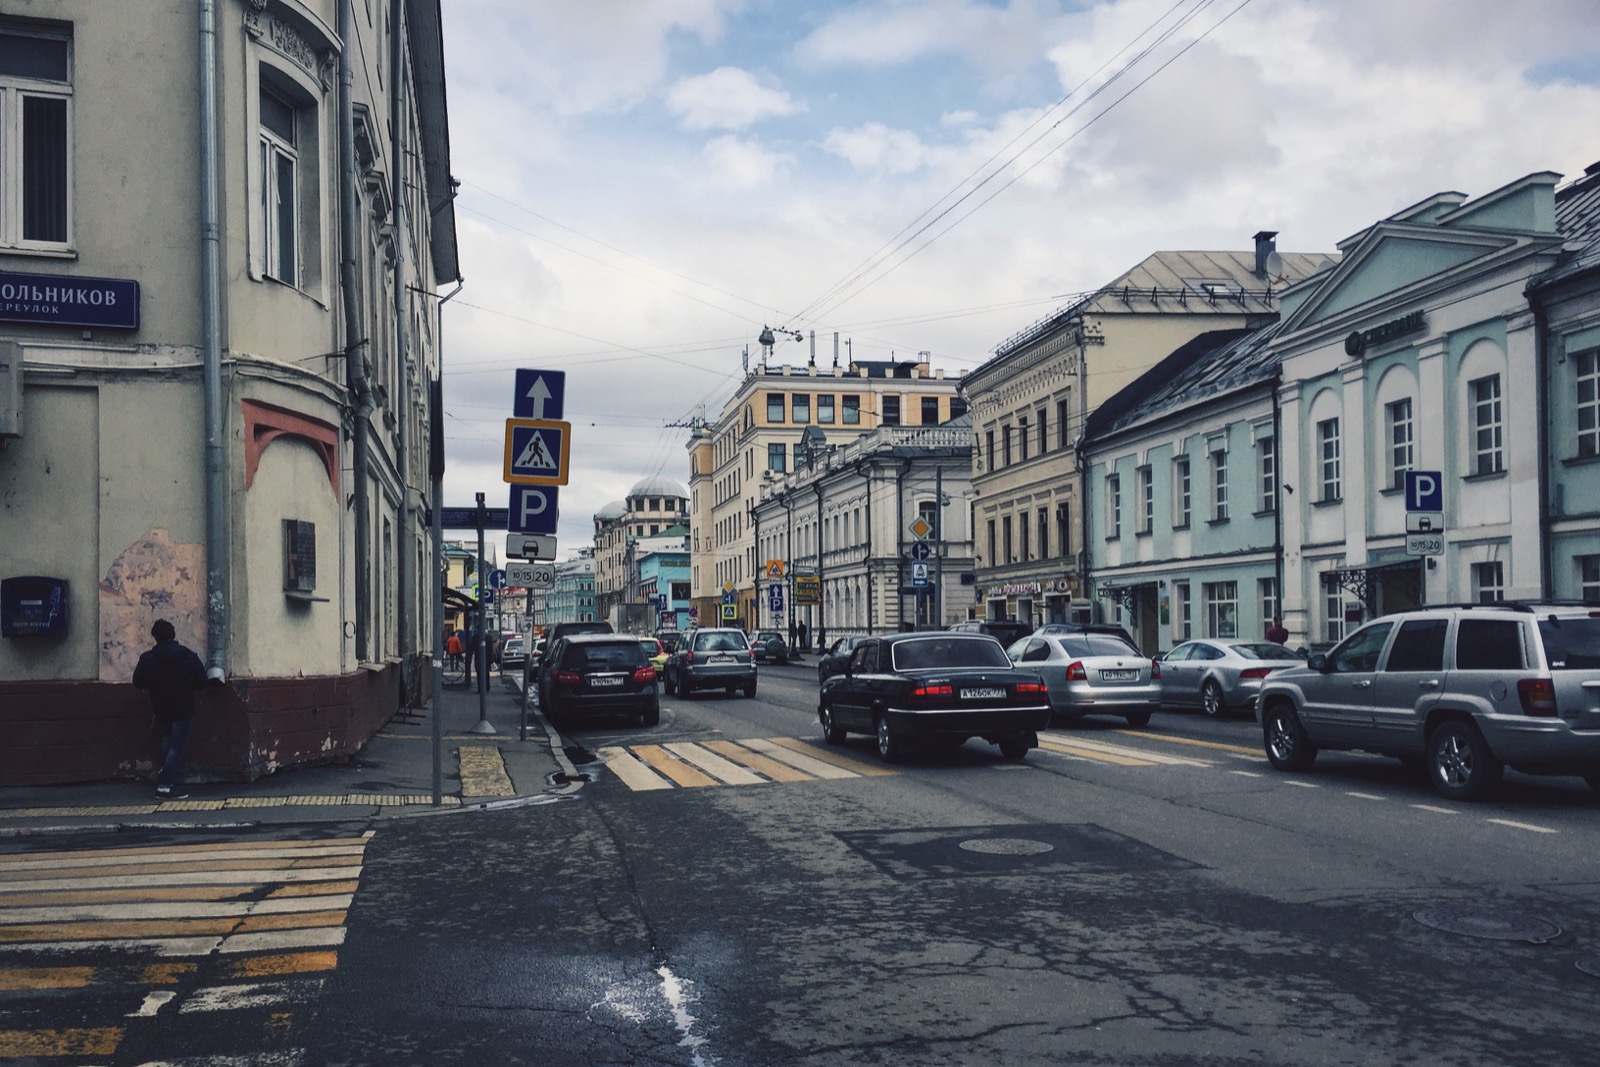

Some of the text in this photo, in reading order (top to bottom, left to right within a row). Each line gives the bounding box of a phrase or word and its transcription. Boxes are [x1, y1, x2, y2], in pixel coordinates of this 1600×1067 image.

[2, 284, 116, 306] ОЛЬНИКОВ
[1415, 475, 1436, 508] P
[520, 489, 548, 528] P
[1428, 540, 1440, 550] 20
[512, 571, 550, 583] 10 15 20
